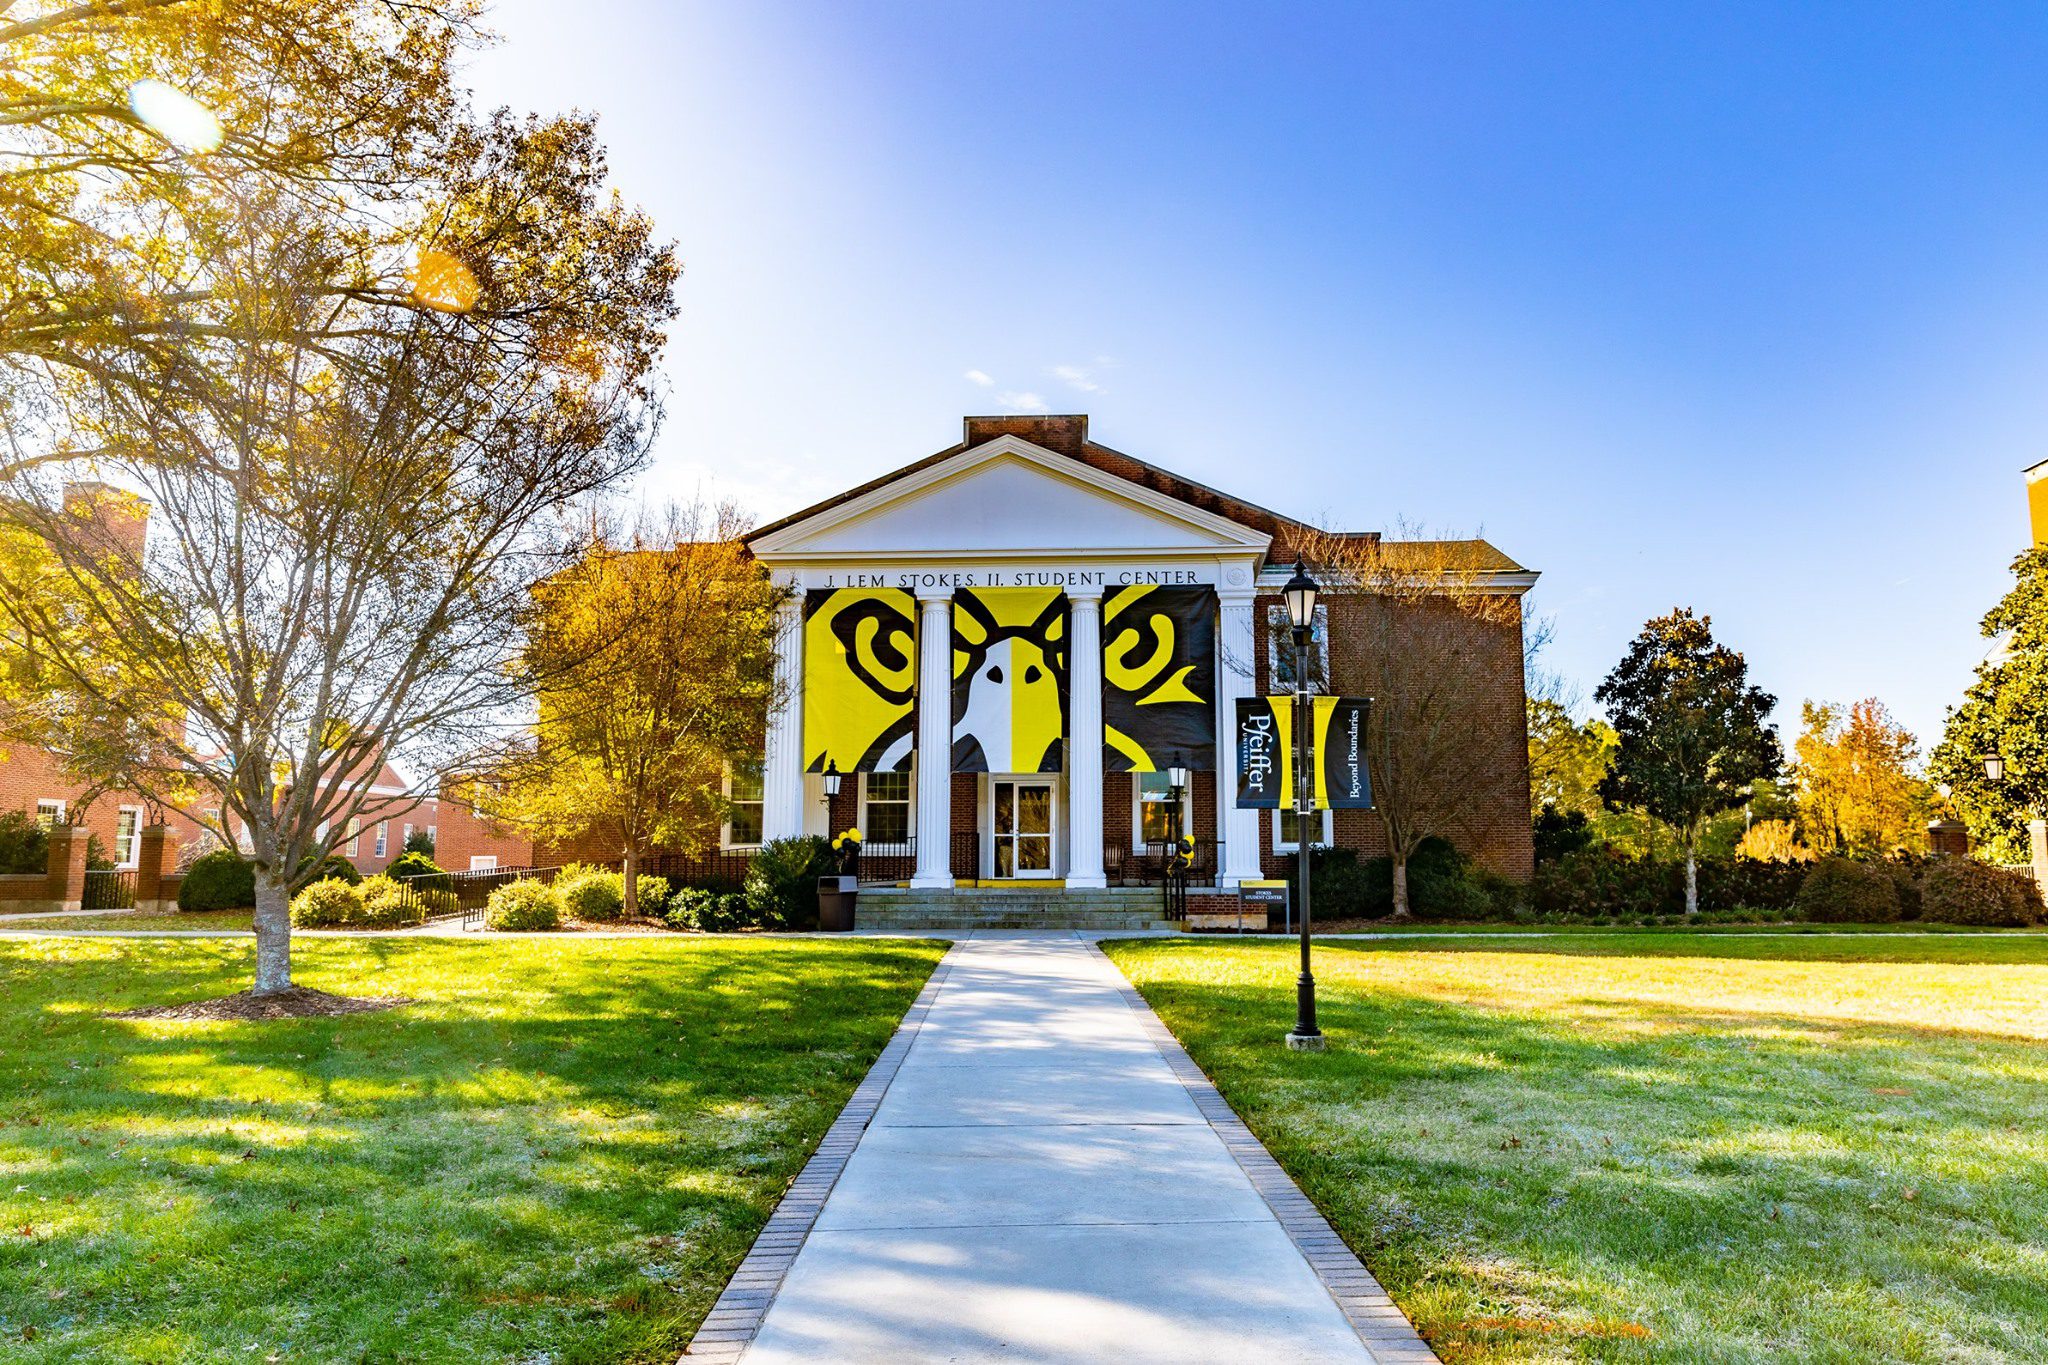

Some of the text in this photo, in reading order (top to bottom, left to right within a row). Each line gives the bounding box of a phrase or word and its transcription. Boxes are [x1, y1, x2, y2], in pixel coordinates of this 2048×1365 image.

[824, 575, 835, 588] J.
[847, 574, 885, 588] LEM
[1014, 572, 1106, 586] STUDENT
[1119, 571, 1198, 585] CENTER
[1241, 713, 1273, 792] Pfeiffer
[1348, 709, 1362, 798] Beyond Boundaries
